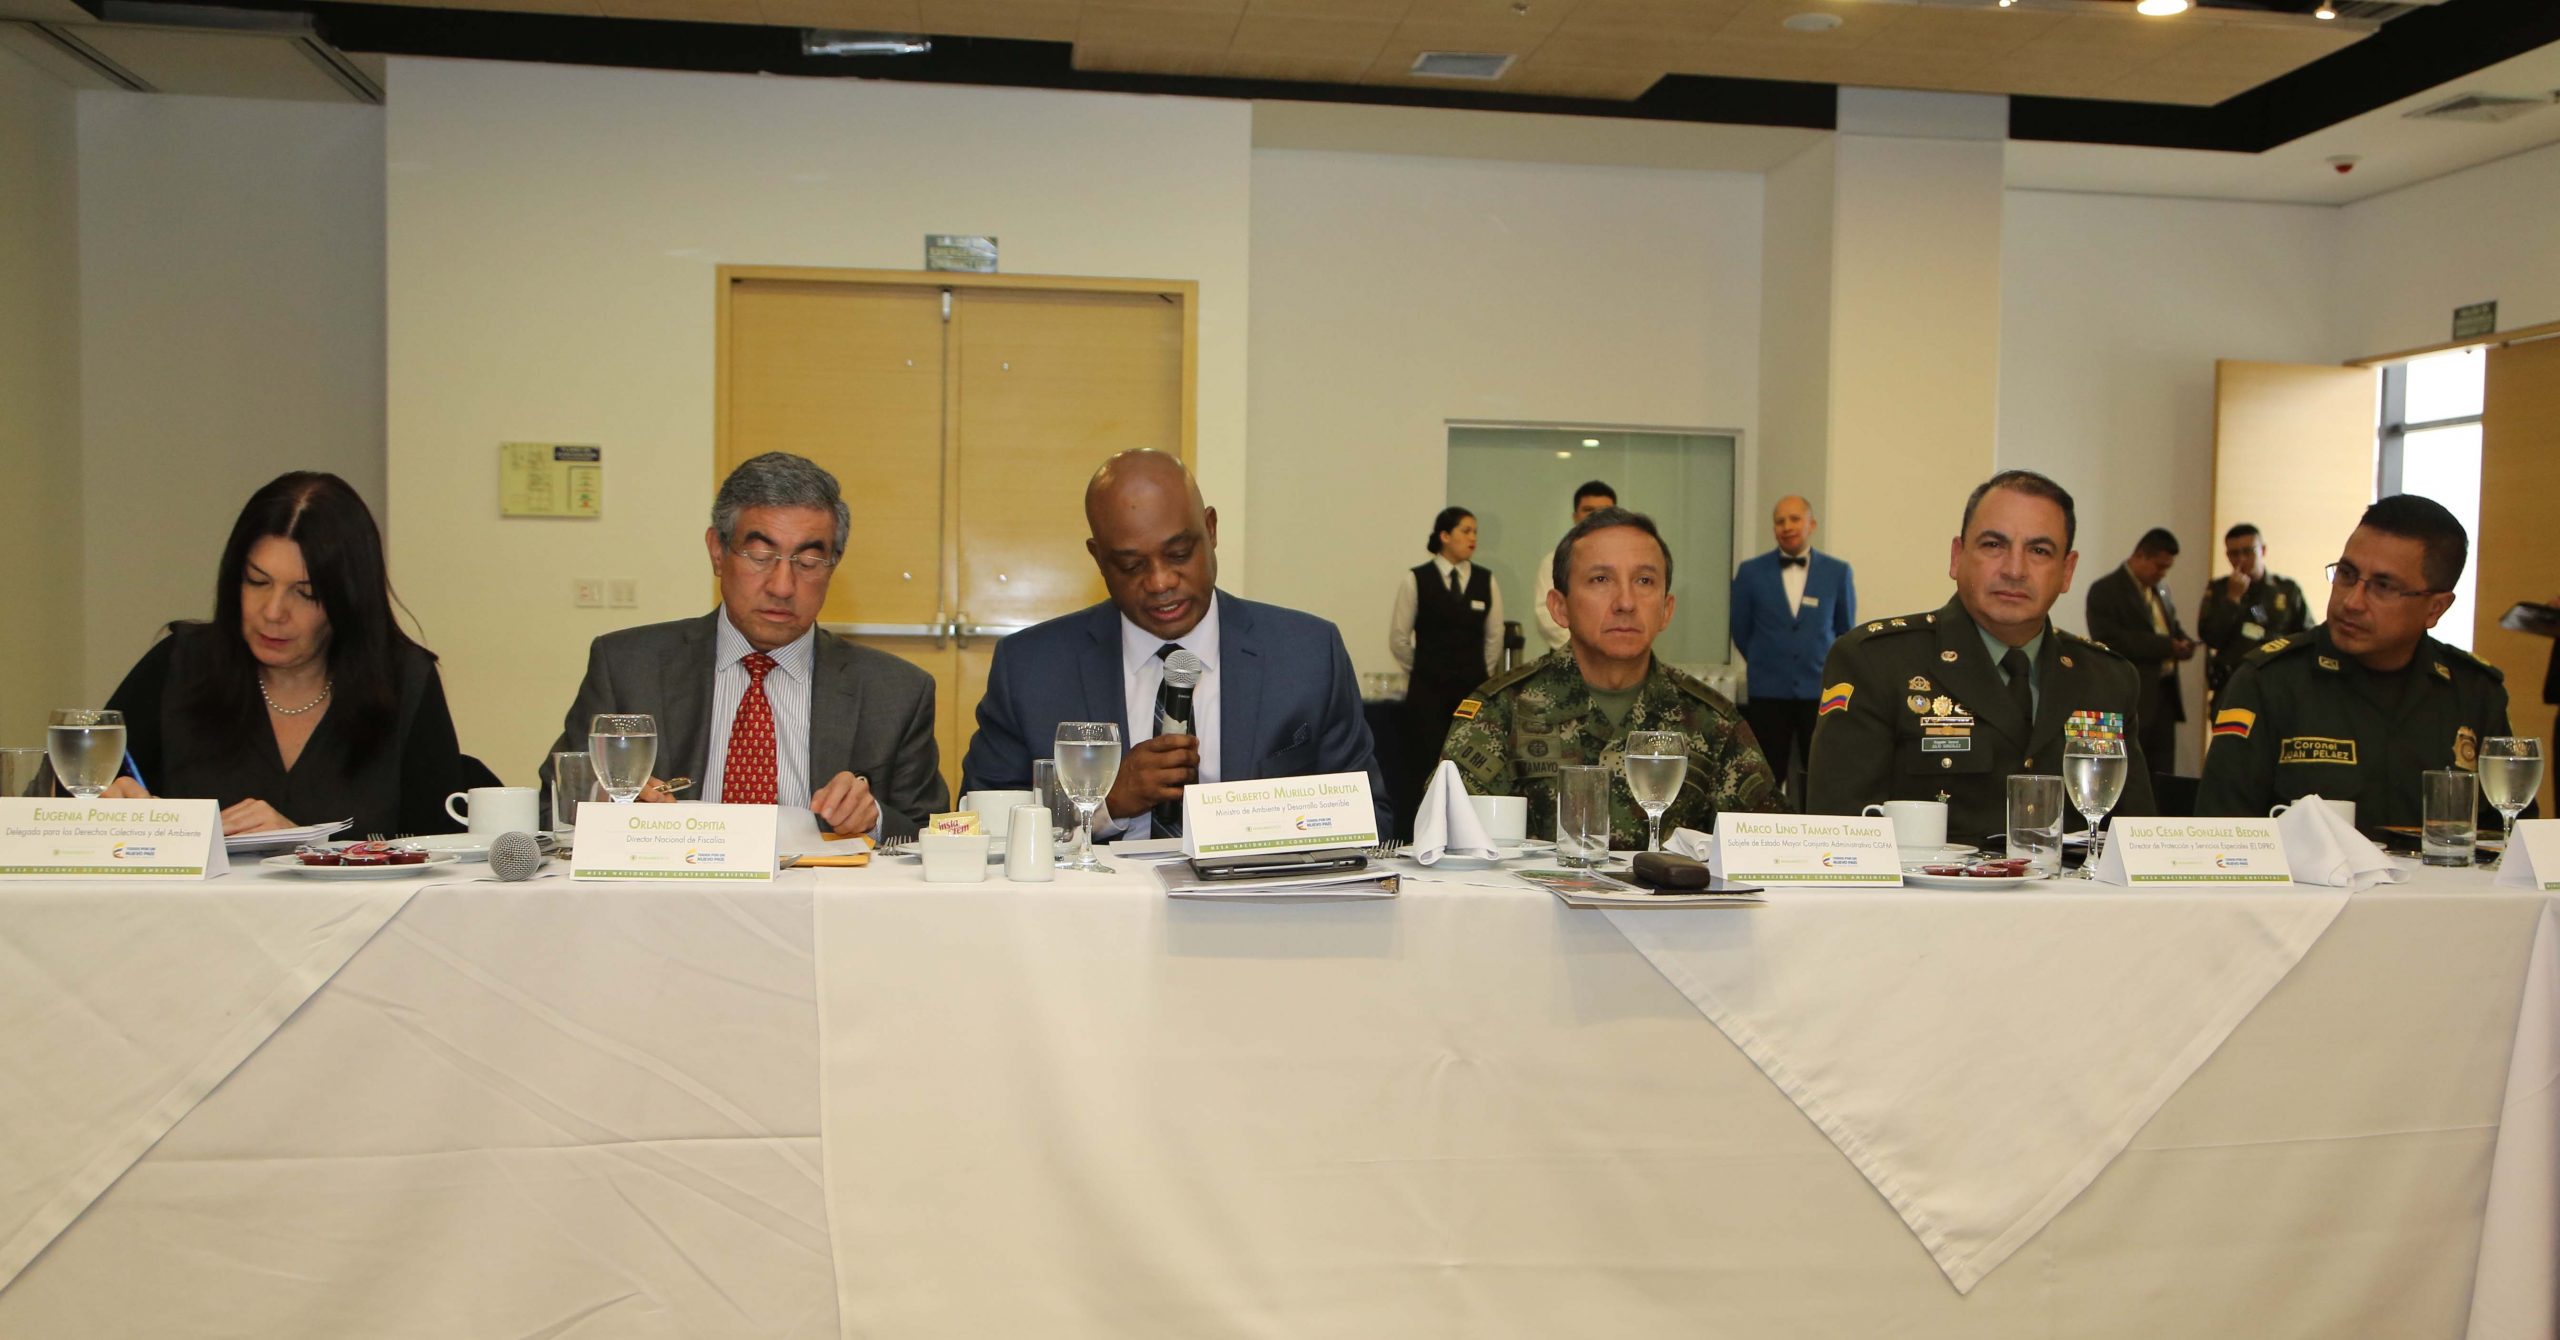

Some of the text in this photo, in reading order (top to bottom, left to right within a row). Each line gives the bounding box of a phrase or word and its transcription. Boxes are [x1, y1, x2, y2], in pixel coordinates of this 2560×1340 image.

[2294, 740, 2337, 750] Coronel
[1469, 752, 1488, 769] RH
[1202, 783, 1359, 805] LUIS GILBERTO MURILLO URRUTIA
[33, 807, 82, 821] EUGENIA
[88, 808, 127, 822] PONCE
[132, 812, 144, 822] DE
[1215, 809, 1240, 817] Ministro
[1252, 805, 1280, 814] Ambiente
[1287, 802, 1317, 811] Desarrollo
[1319, 799, 1350, 809] Sostenible
[629, 816, 726, 831] ORLANDO OSPITIA
[1736, 822, 1882, 837] MARCO LINO TAMAYO TAMAYO
[43, 829, 60, 838] para
[62, 826, 72, 836] los
[74, 827, 107, 836] Derechos
[110, 827, 146, 837] Colectivos
[147, 830, 152, 838] y
[154, 828, 165, 837] del
[168, 828, 202, 837] Ambiente
[2129, 826, 2153, 838] JULIO
[2235, 826, 2270, 838] BEDOYA
[626, 835, 652, 843] Director
[654, 835, 686, 844] Nacional
[687, 836, 696, 844] de
[1751, 839, 1760, 847] de
[1760, 839, 1780, 847] Estado
[1782, 840, 1801, 849] Mayor
[1803, 840, 1829, 849] Conjunto
[1831, 840, 1872, 849] Administrativo
[2129, 842, 2151, 850] Director
[2195, 842, 2220, 850] Servicios
[2220, 842, 2248, 851] Especiales
